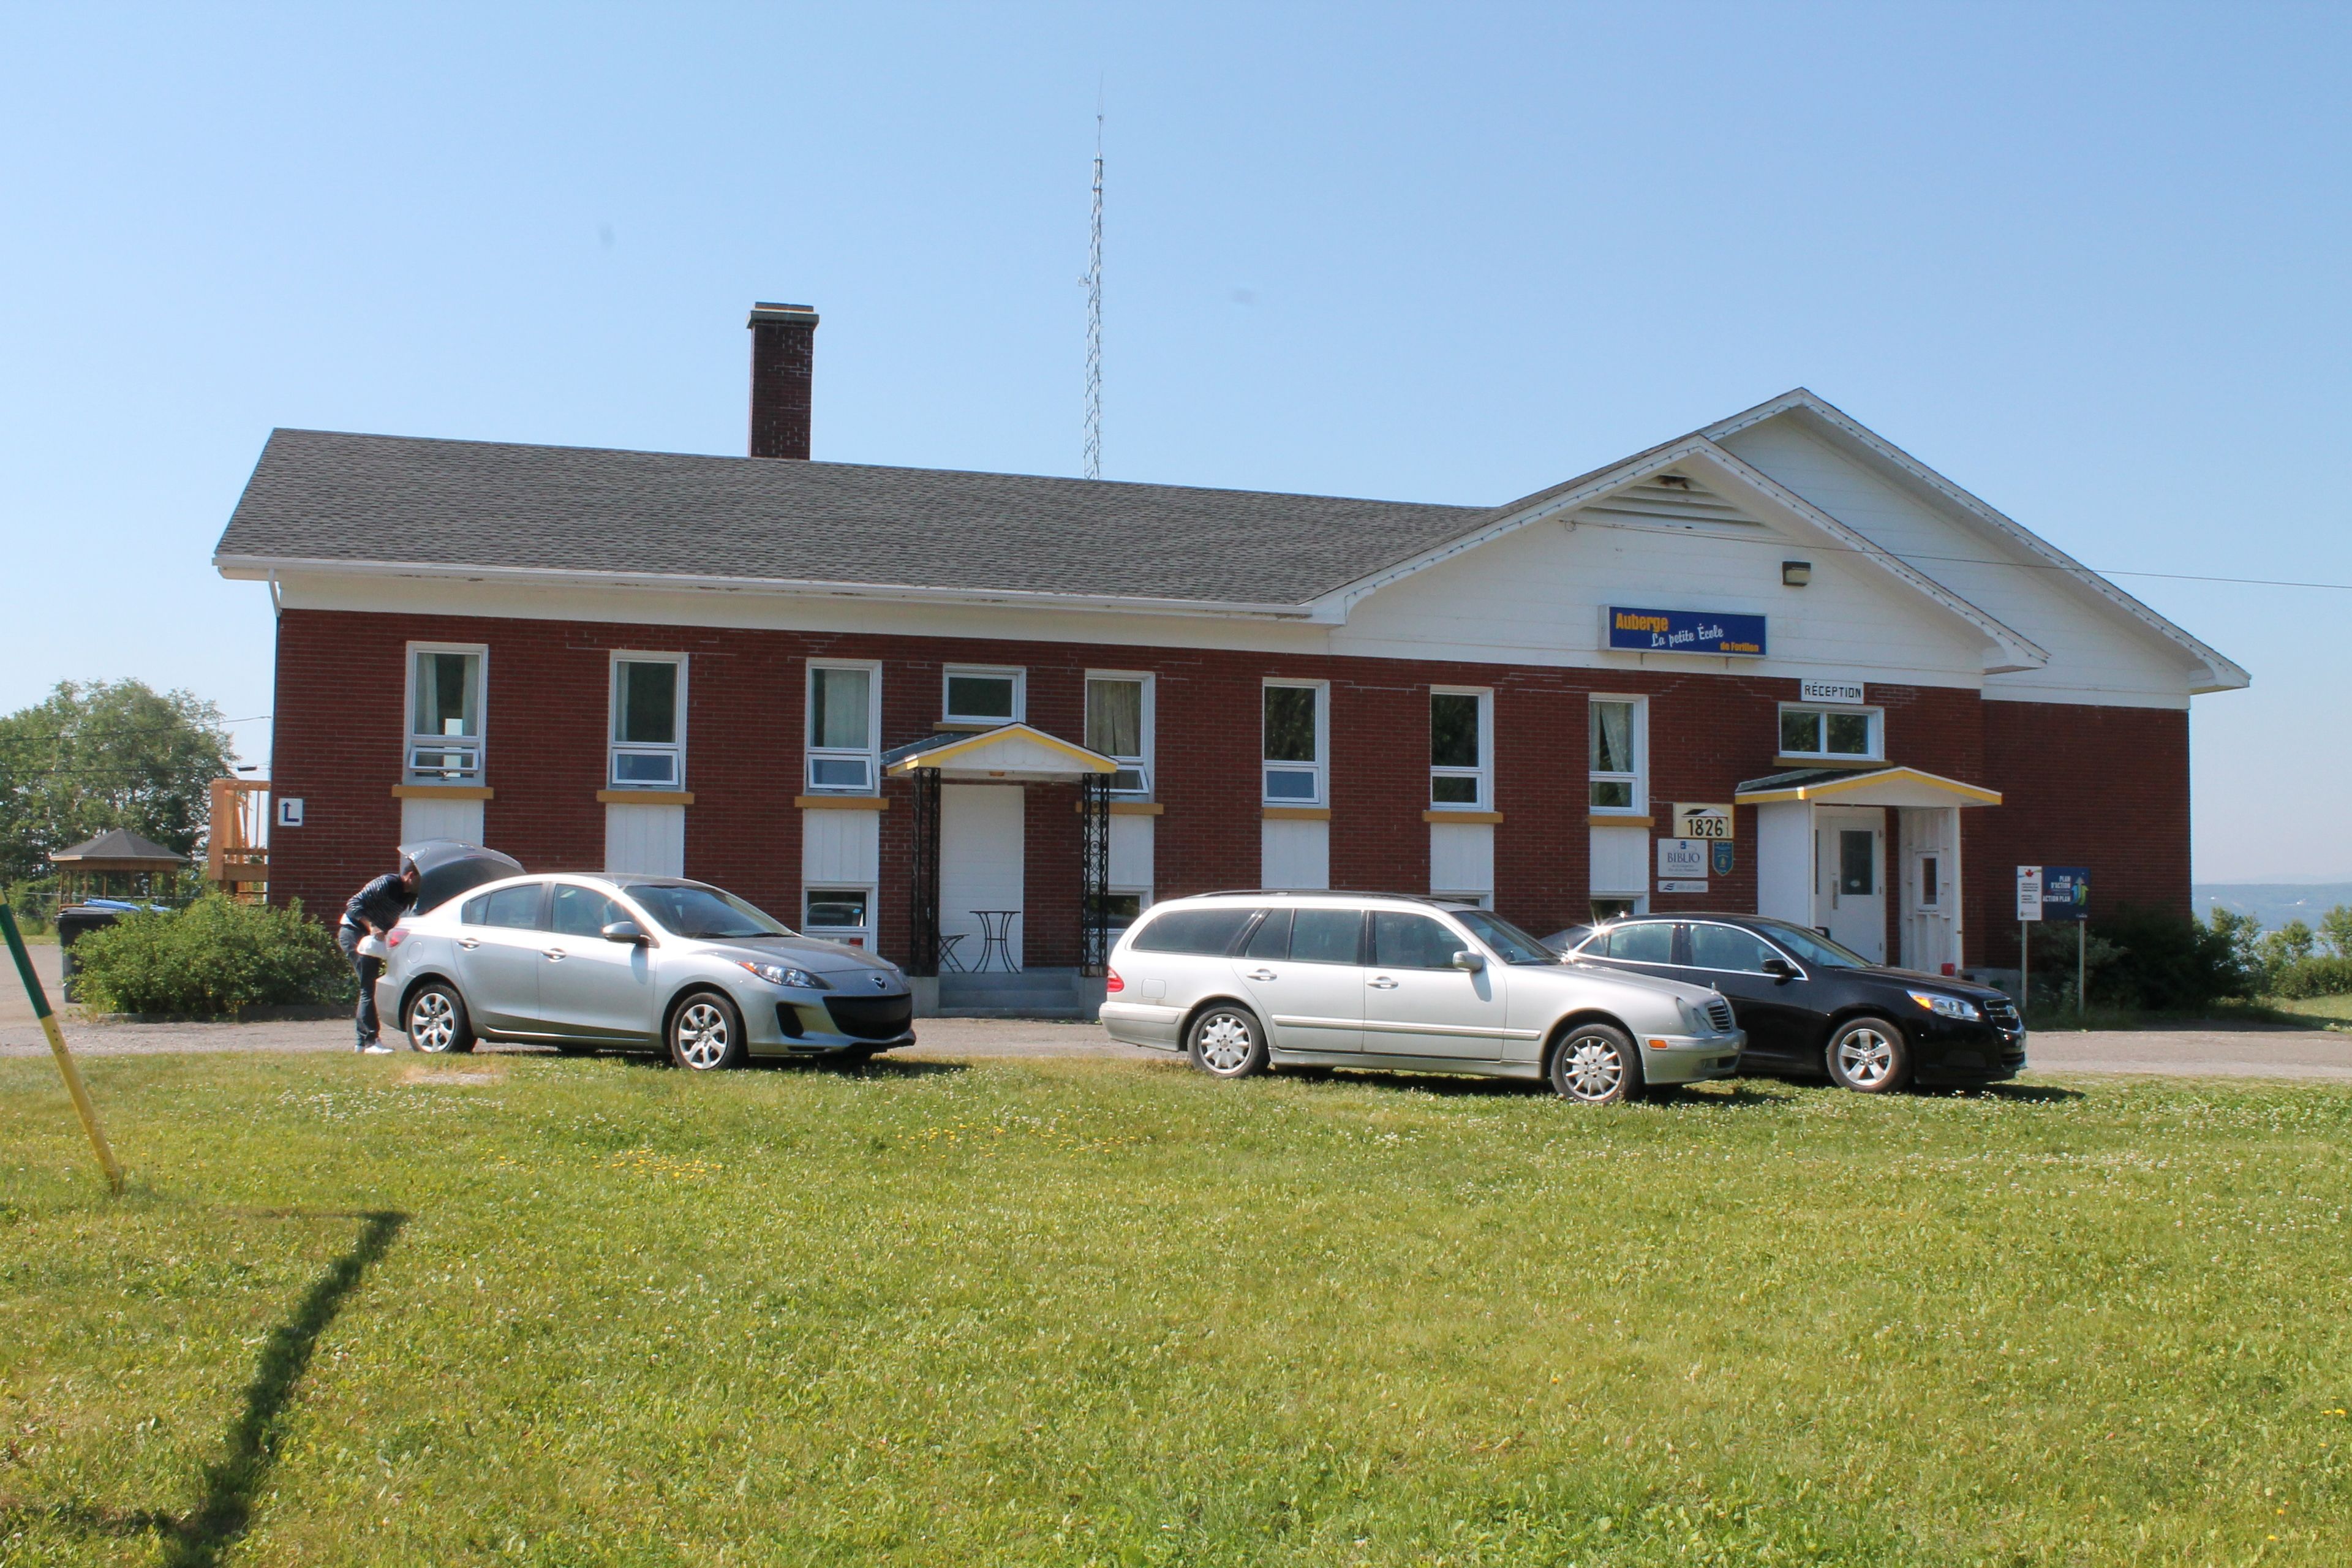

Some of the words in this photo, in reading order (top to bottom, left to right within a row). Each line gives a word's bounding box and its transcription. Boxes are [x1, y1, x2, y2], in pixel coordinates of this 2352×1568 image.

[1616, 613, 1668, 632] Auberge
[1651, 633, 1665, 647] La
[1669, 630, 1695, 647] petite
[1697, 623, 1724, 640] École
[1720, 641, 1730, 651] de
[1731, 642, 1759, 652] Forillon
[1804, 682, 1861, 698] RÉCEPTION
[1688, 819, 1723, 837] 1826
[1667, 852, 1700, 863] BIBLIO
